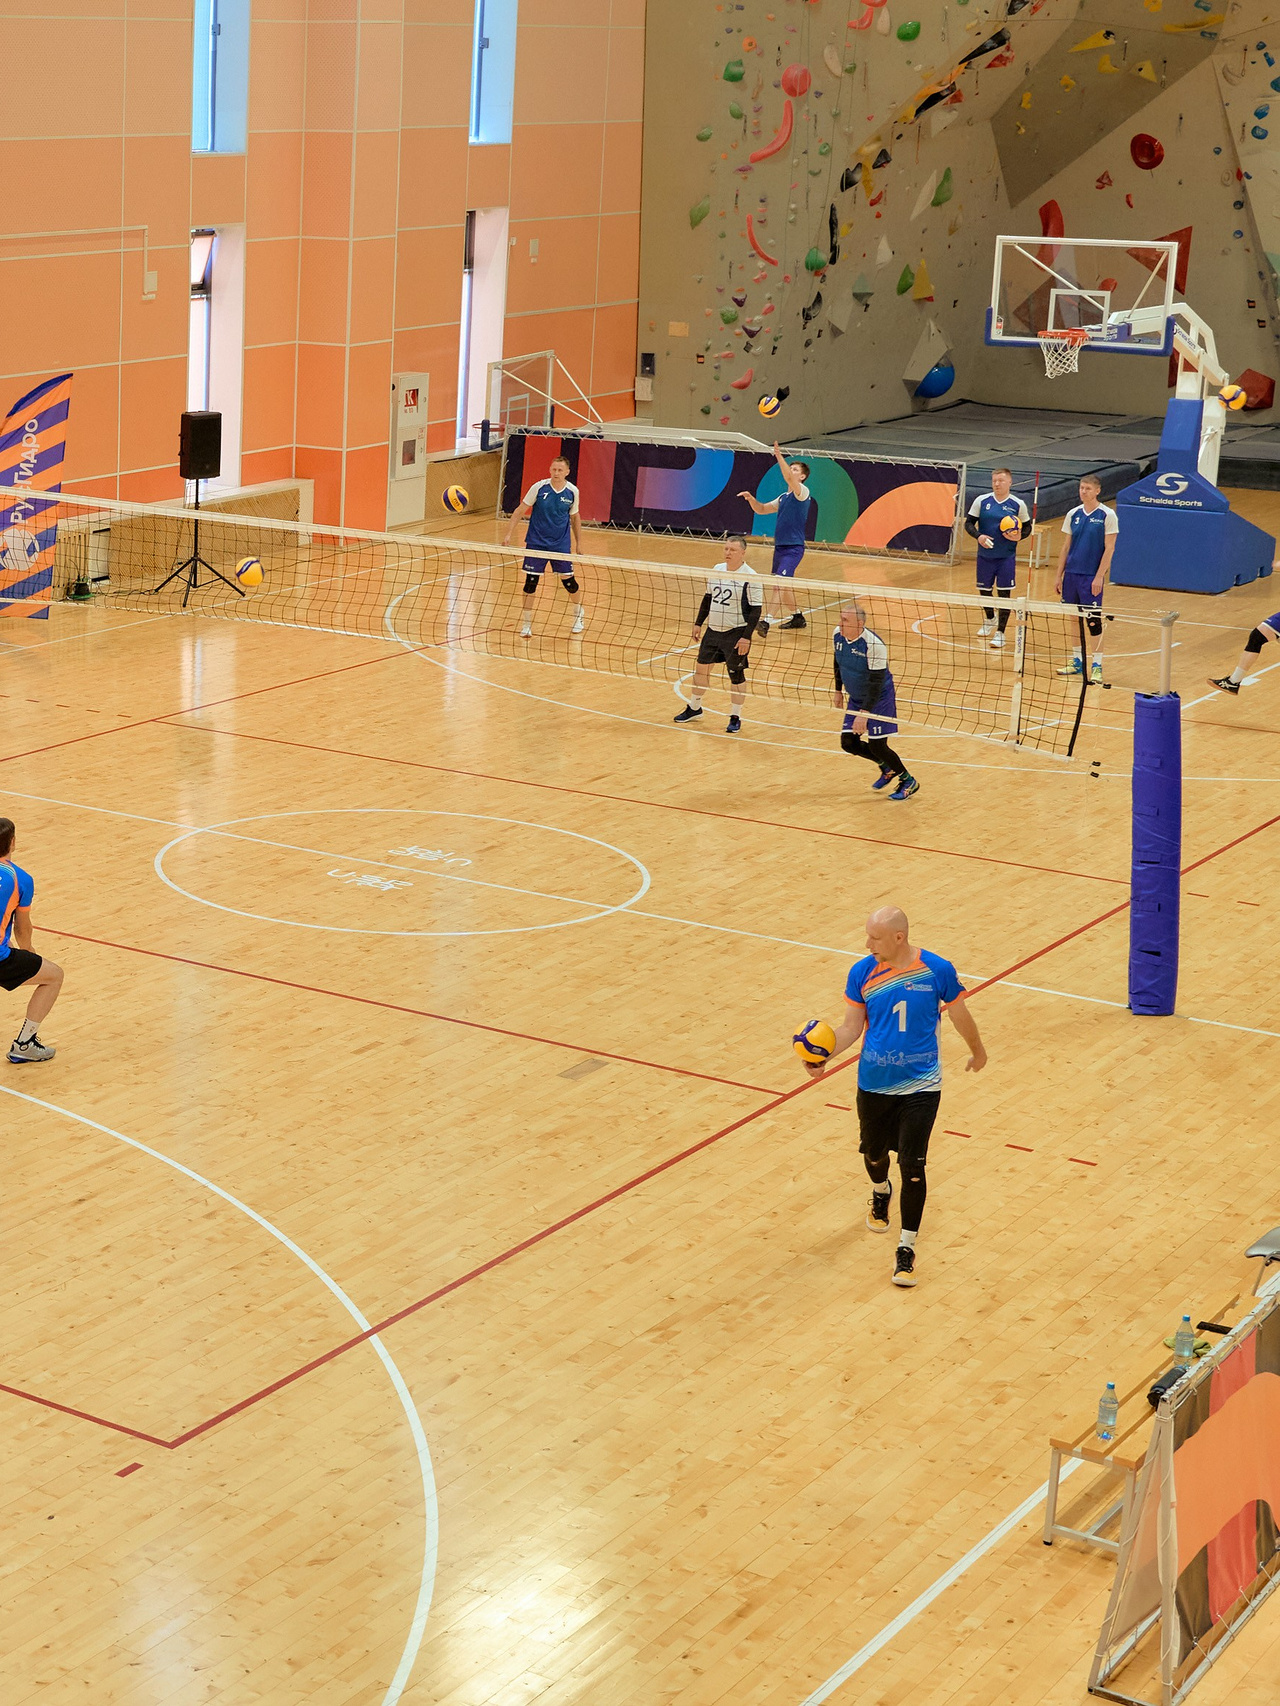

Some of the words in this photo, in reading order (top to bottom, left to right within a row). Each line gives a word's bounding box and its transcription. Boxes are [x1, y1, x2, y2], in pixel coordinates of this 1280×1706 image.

[542, 492, 549, 500] 7
[1139, 496, 1174, 505] Schelde
[1174, 499, 1203, 507] Sports
[712, 586, 732, 606] 22
[836, 641, 843, 651] 11
[872, 726, 882, 734] 11
[892, 1000, 907, 1032] 1
